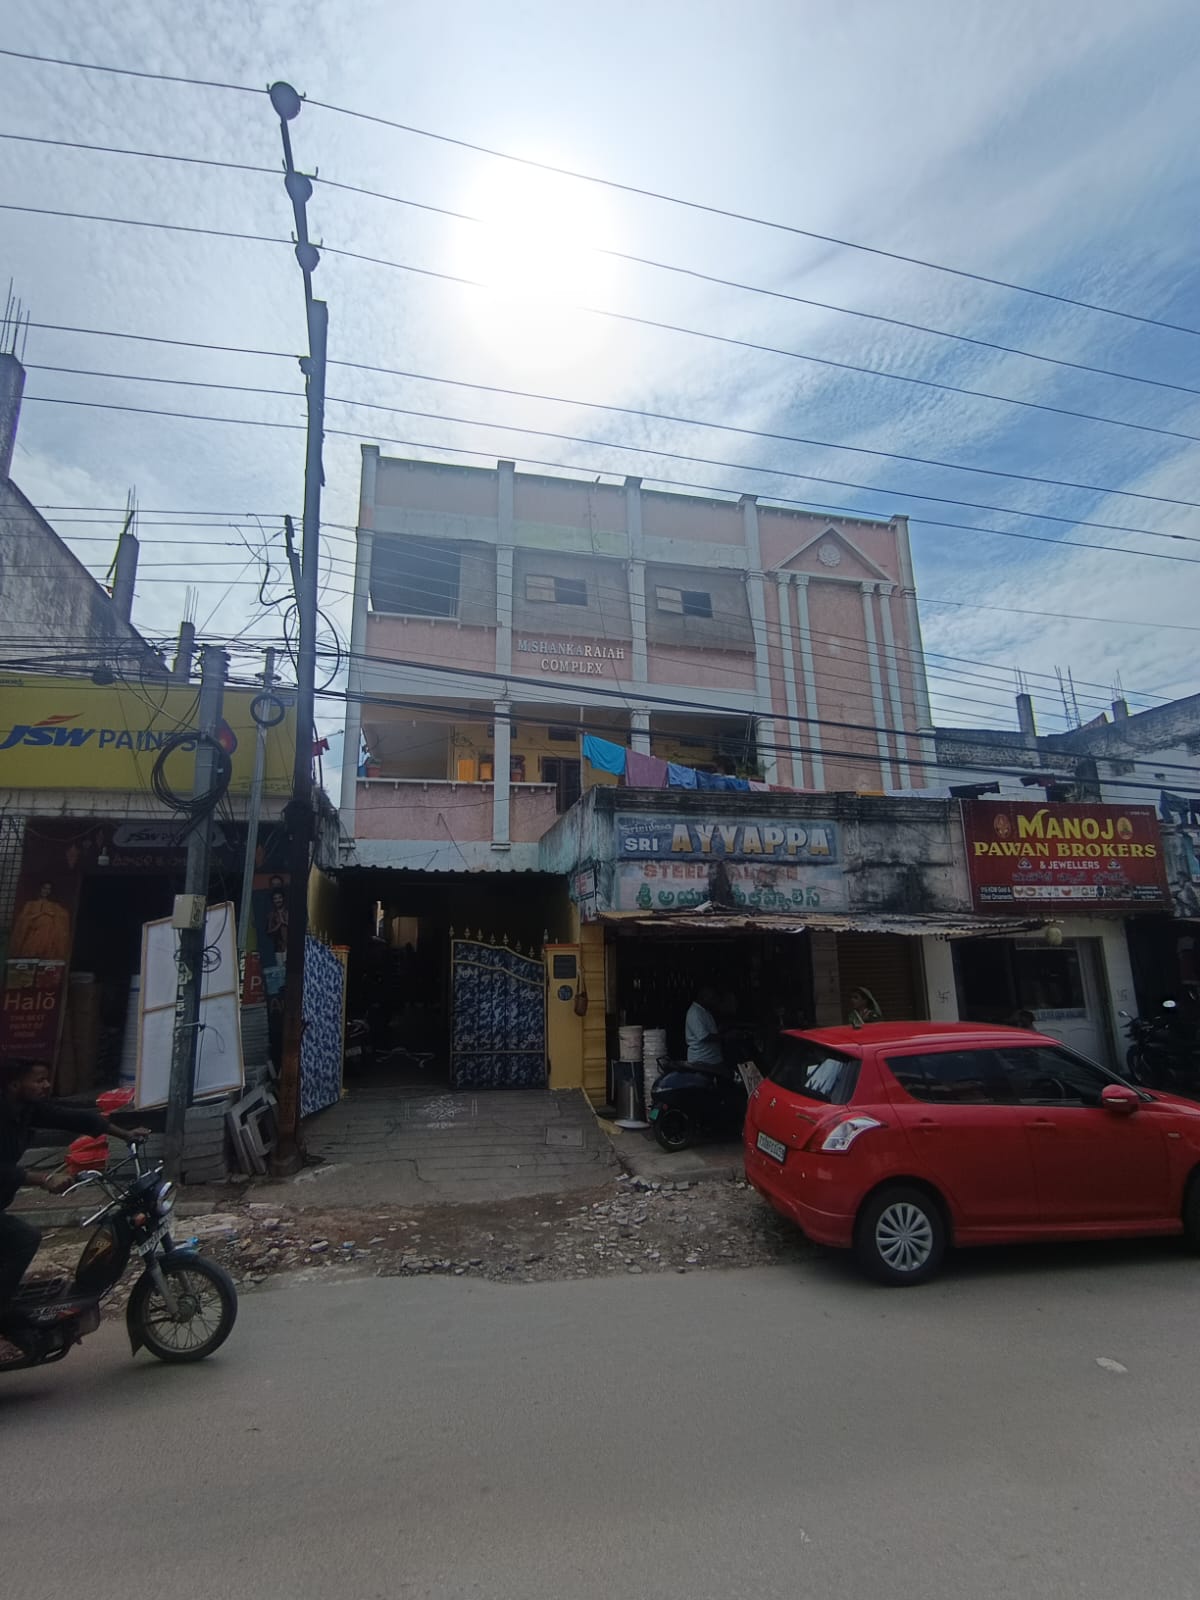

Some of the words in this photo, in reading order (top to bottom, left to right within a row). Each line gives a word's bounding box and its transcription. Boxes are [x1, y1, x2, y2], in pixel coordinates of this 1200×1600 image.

[541, 658, 604, 675] COMPLEX
[0, 725, 94, 750] JSW
[1016, 809, 1114, 840] MANOJ
[624, 837, 659, 852] SRI
[671, 823, 830, 857] AYYAPPA
[973, 841, 1050, 857] PAWAN
[1057, 843, 1157, 858] BROKERS
[643, 863, 708, 880] STEEL
[1040, 860, 1047, 870] &
[1048, 860, 1101, 870] JEWELLERS
